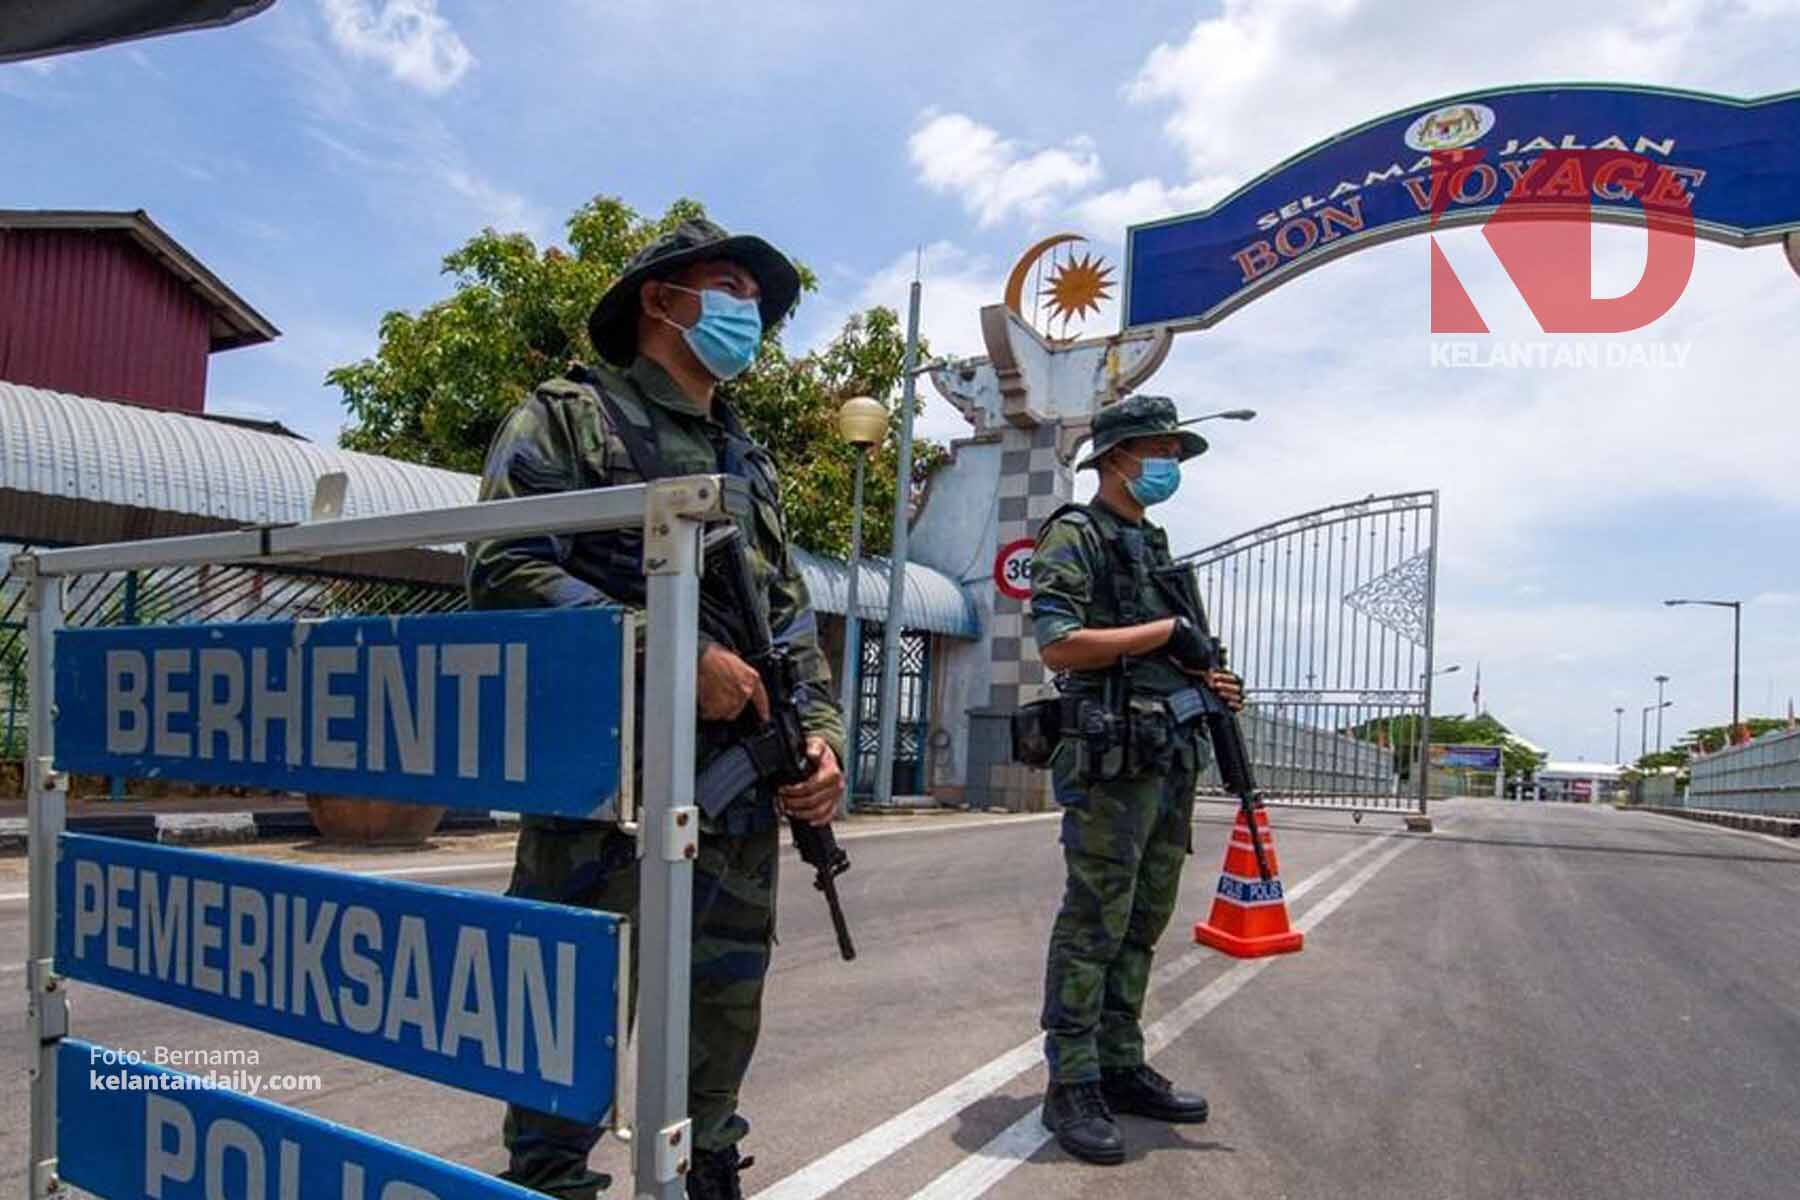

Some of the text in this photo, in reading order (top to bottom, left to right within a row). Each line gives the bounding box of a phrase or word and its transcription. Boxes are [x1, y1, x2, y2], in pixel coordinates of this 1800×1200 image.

[1500, 135, 1675, 156] JALAN
[1231, 157, 1706, 283] BON VOYAGE
[106, 642, 527, 782] BERHENTI
[74, 861, 576, 1087] PEMERIKSAAN
